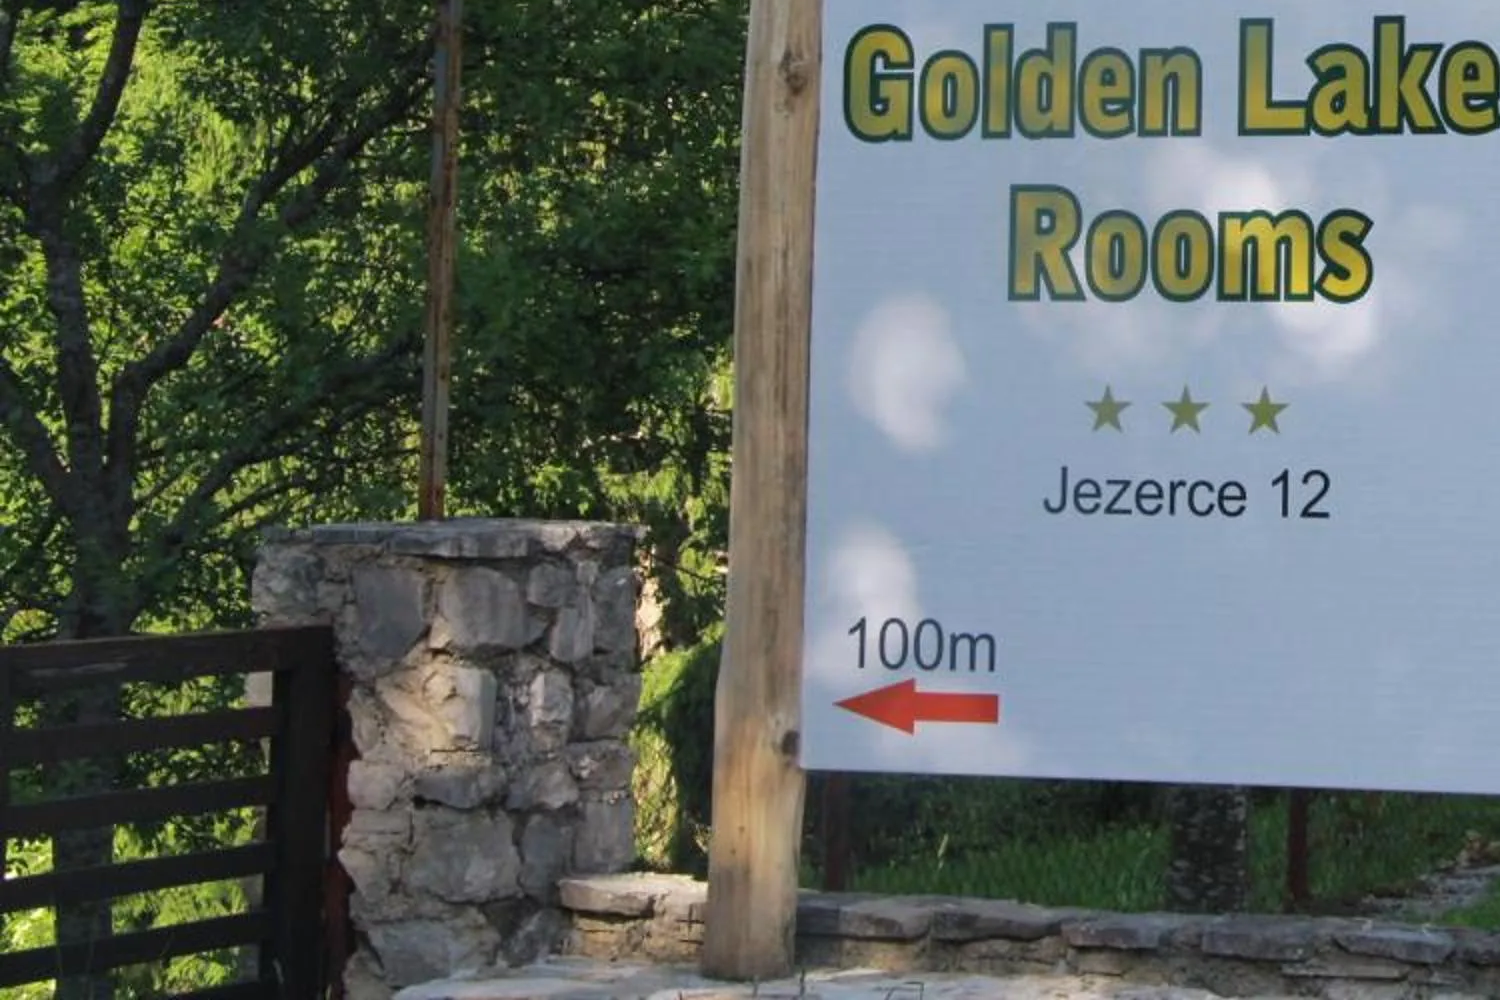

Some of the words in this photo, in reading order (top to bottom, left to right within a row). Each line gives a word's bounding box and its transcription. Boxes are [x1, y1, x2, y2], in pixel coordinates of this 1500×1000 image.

[843, 22, 1202, 143] Golden
[1007, 182, 1375, 304] Rooms
[1042, 465, 1248, 518] Jezerce
[1270, 469, 1331, 520] 12
[847, 616, 997, 673] 100m
